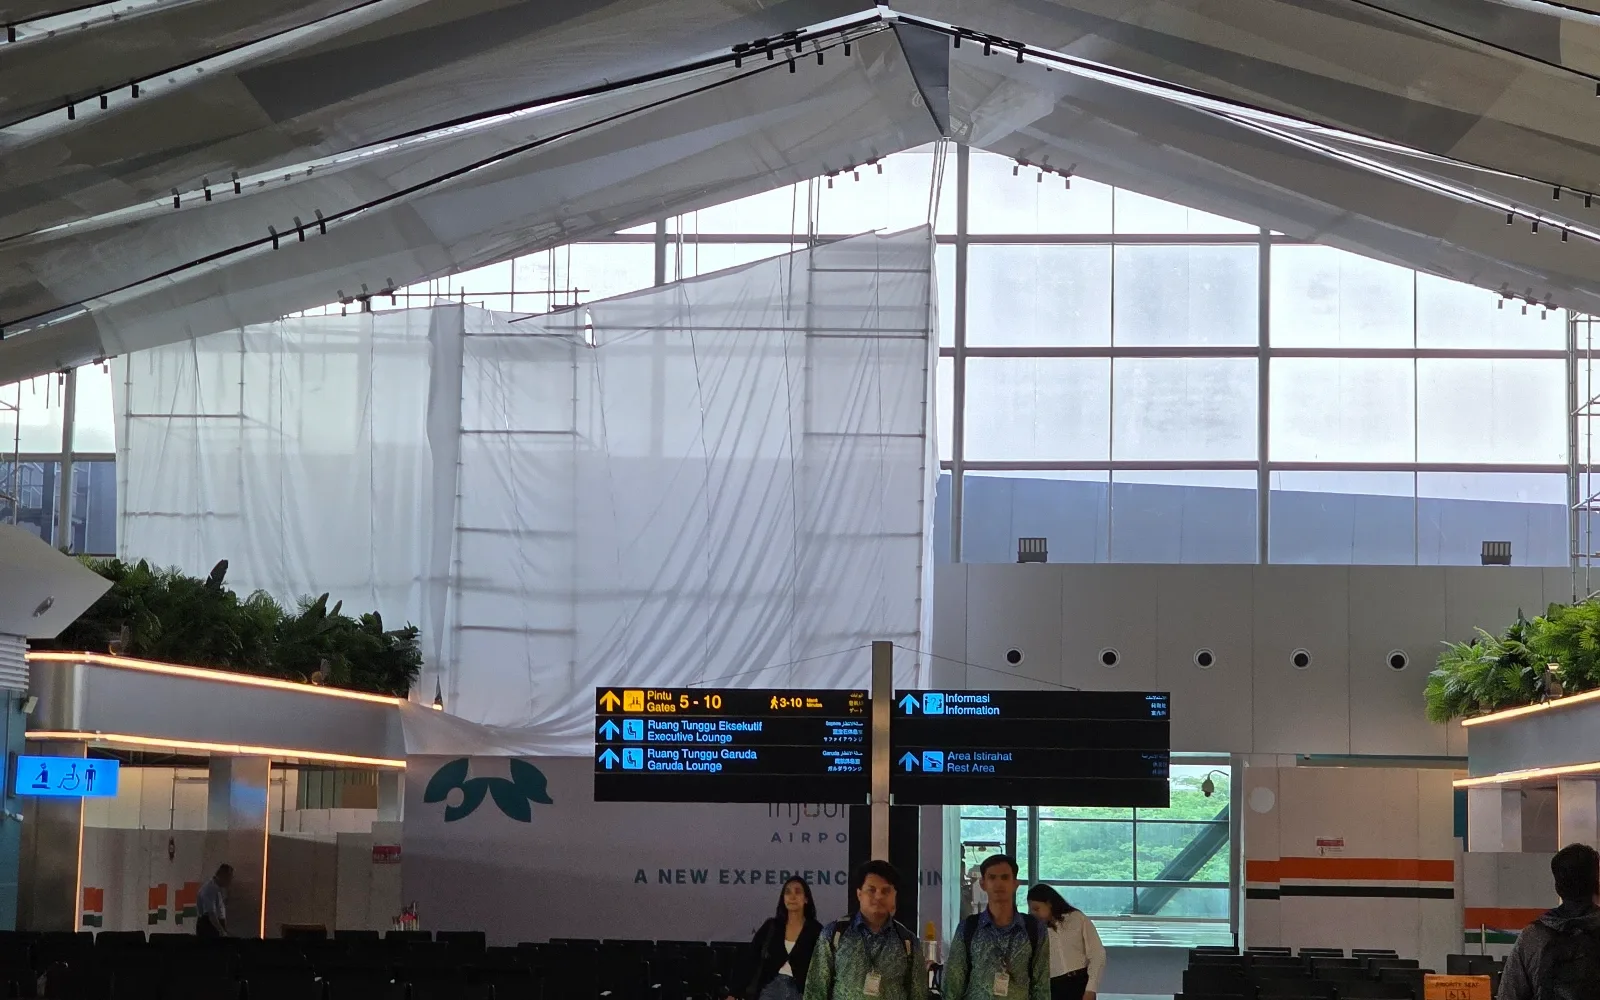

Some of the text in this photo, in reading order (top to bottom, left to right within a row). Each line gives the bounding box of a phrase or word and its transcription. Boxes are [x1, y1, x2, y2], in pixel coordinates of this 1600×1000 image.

[647, 690, 673, 700] Pintu
[945, 693, 990, 703] Informasi
[647, 702, 677, 713] Gates
[680, 695, 690, 709] 5
[704, 695, 722, 710] 10
[779, 697, 803, 709] 3-10
[945, 704, 1001, 715] Information
[648, 720, 763, 734] Ruang Tunggu Eksekutif
[648, 732, 733, 746] Executive Lounge
[648, 748, 758, 762] Ruang Tunggu Garuda
[948, 752, 1013, 761] Area Istirahat
[647, 759, 723, 773] Garuda Lounge
[947, 763, 996, 773] Rest Area
[771, 832, 848, 844] AIRPO
[634, 868, 848, 886] A NEW EXPERIENC
